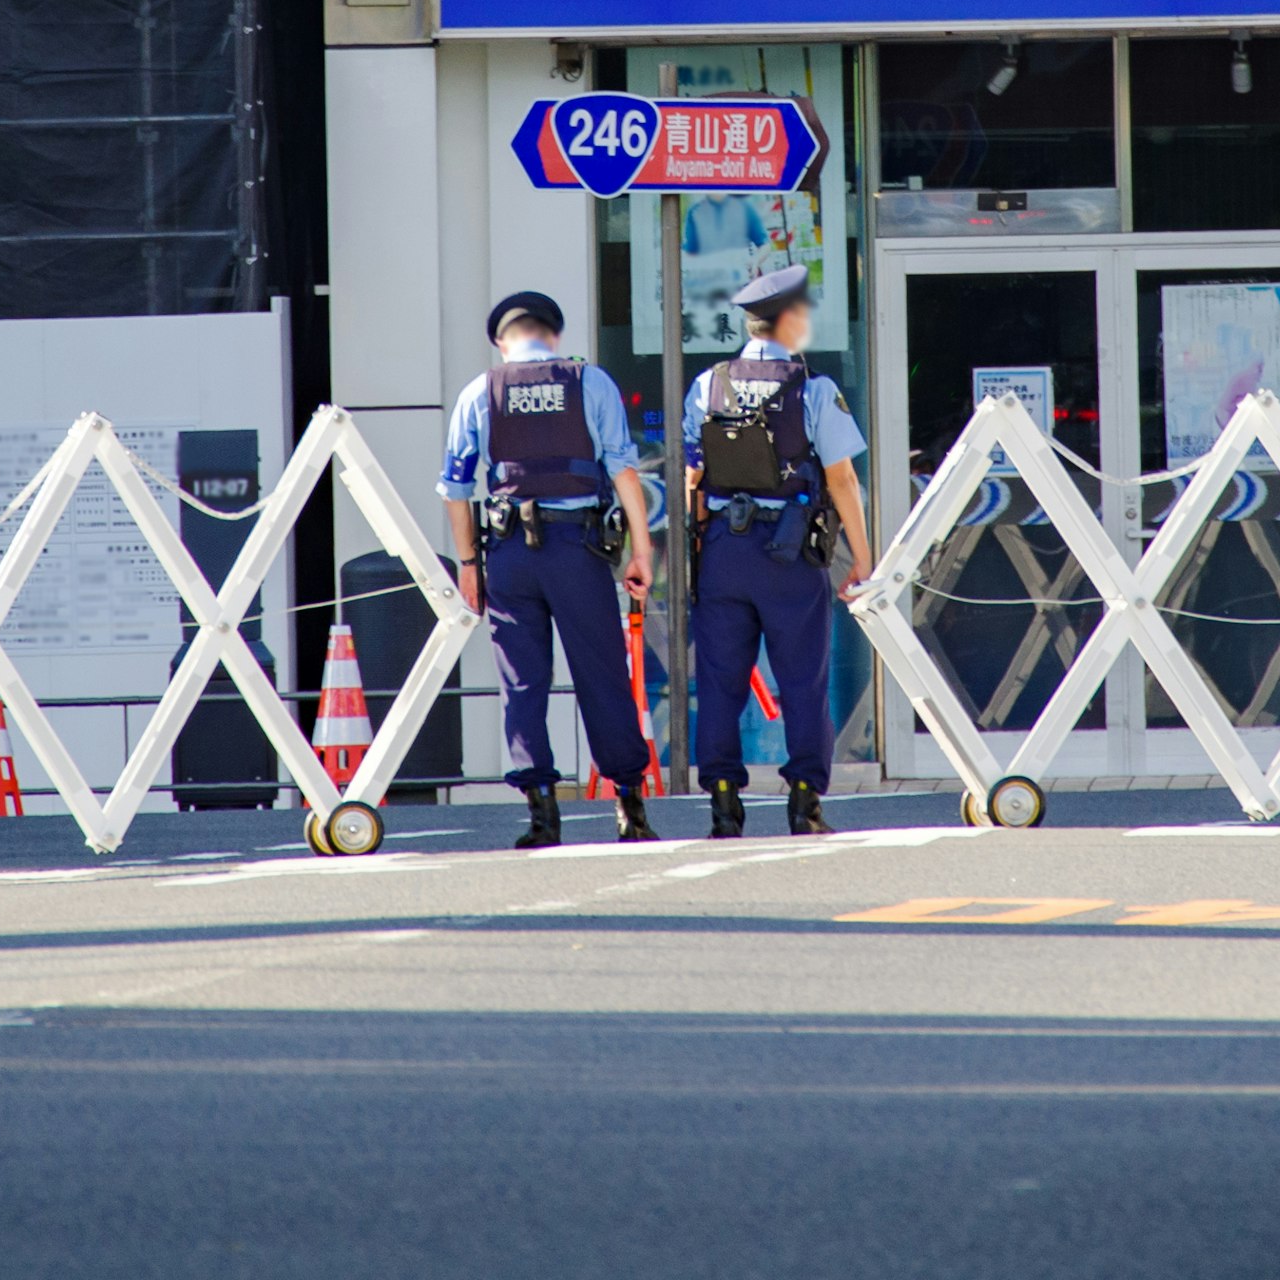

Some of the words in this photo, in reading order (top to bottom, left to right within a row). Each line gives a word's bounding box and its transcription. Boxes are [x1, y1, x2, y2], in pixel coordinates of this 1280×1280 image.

[568, 108, 648, 158] 246
[664, 113, 777, 156] 青山通り
[665, 156, 745, 182] Aoyama-dori
[508, 398, 566, 414] POLICE
